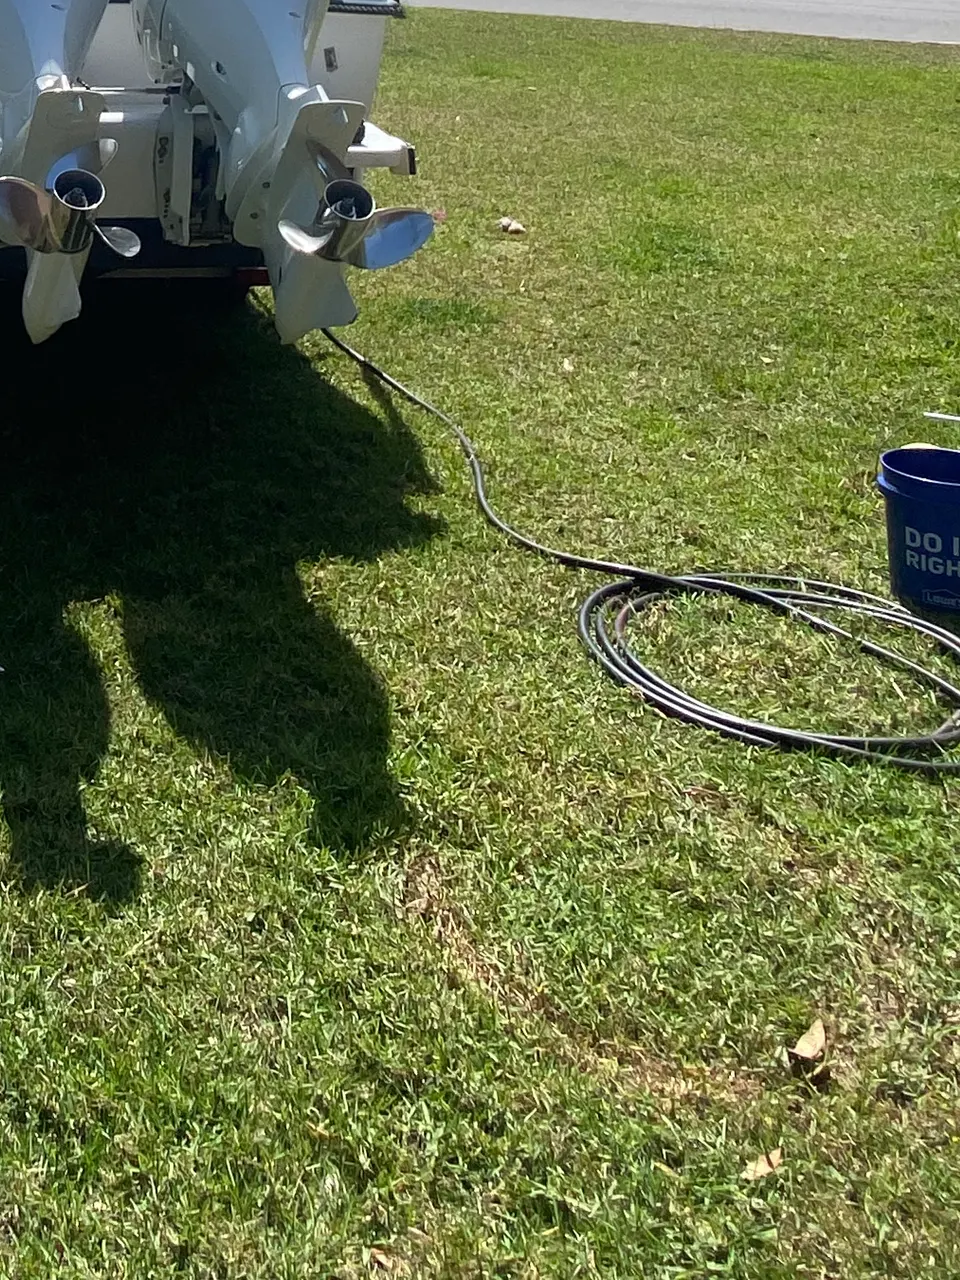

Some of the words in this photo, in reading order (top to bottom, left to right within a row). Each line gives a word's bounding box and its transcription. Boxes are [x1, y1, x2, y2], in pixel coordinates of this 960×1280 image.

[905, 526, 943, 553] DO
[952, 536, 960, 557] I
[906, 549, 960, 579] RIGH
